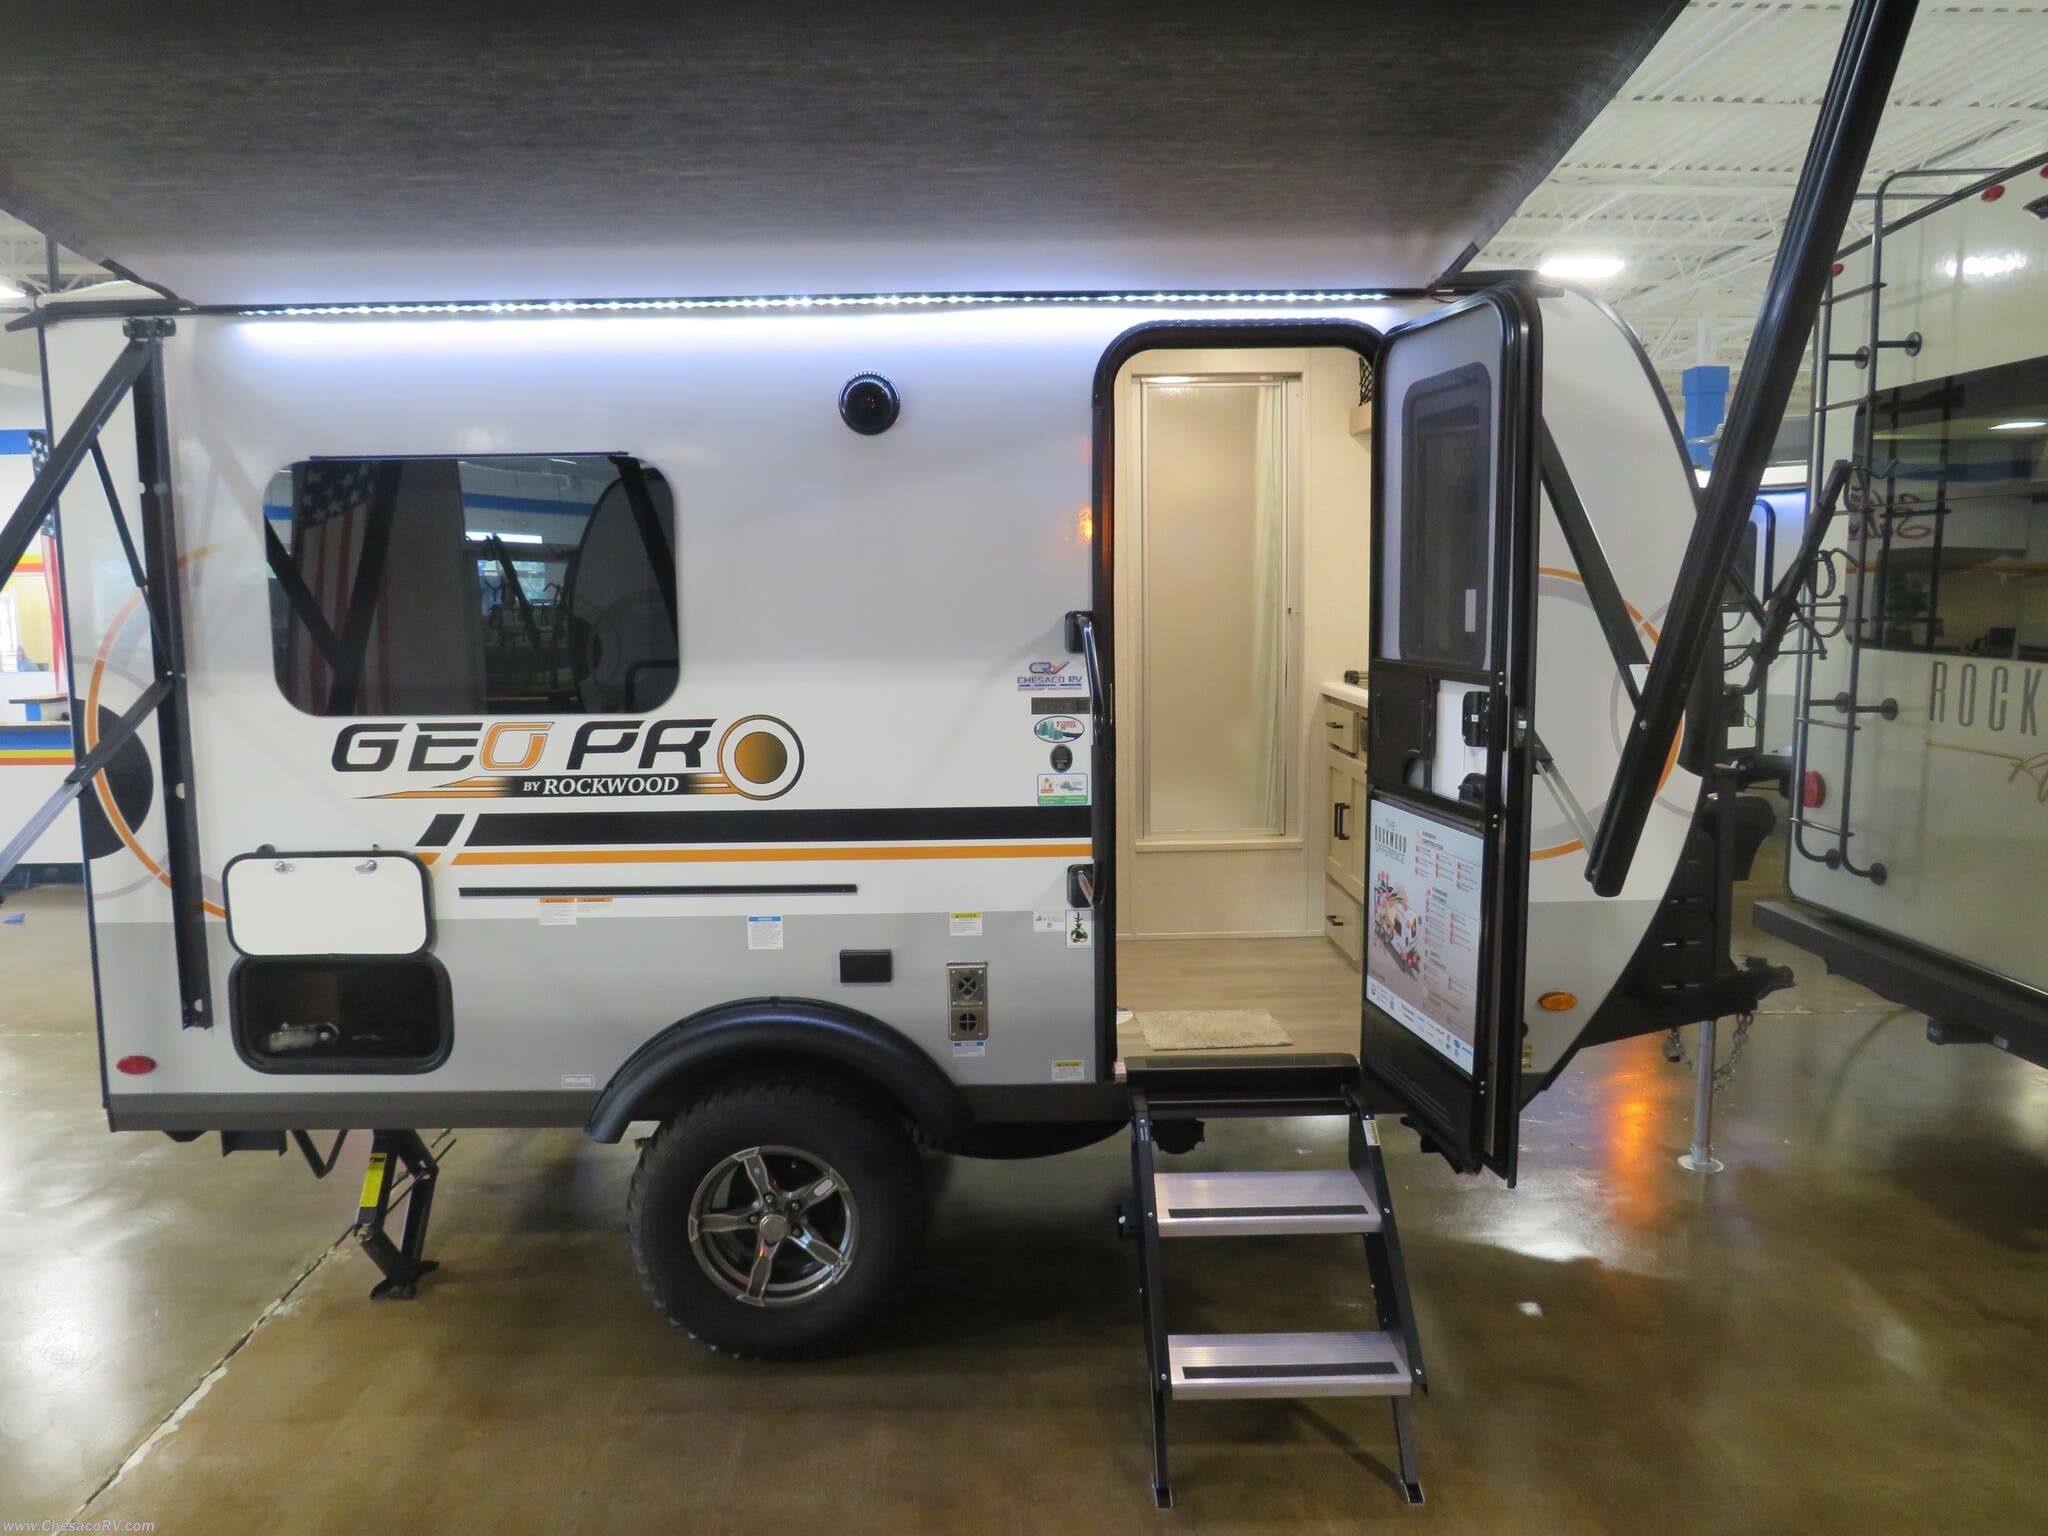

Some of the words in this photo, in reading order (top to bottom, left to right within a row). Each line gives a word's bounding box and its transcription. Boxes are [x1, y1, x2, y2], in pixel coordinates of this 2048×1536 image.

[1017, 676, 1065, 684] CHESACO
[331, 721, 556, 772] GEO
[522, 780, 540, 792] BY
[543, 776, 680, 795] ROCKWOOD
